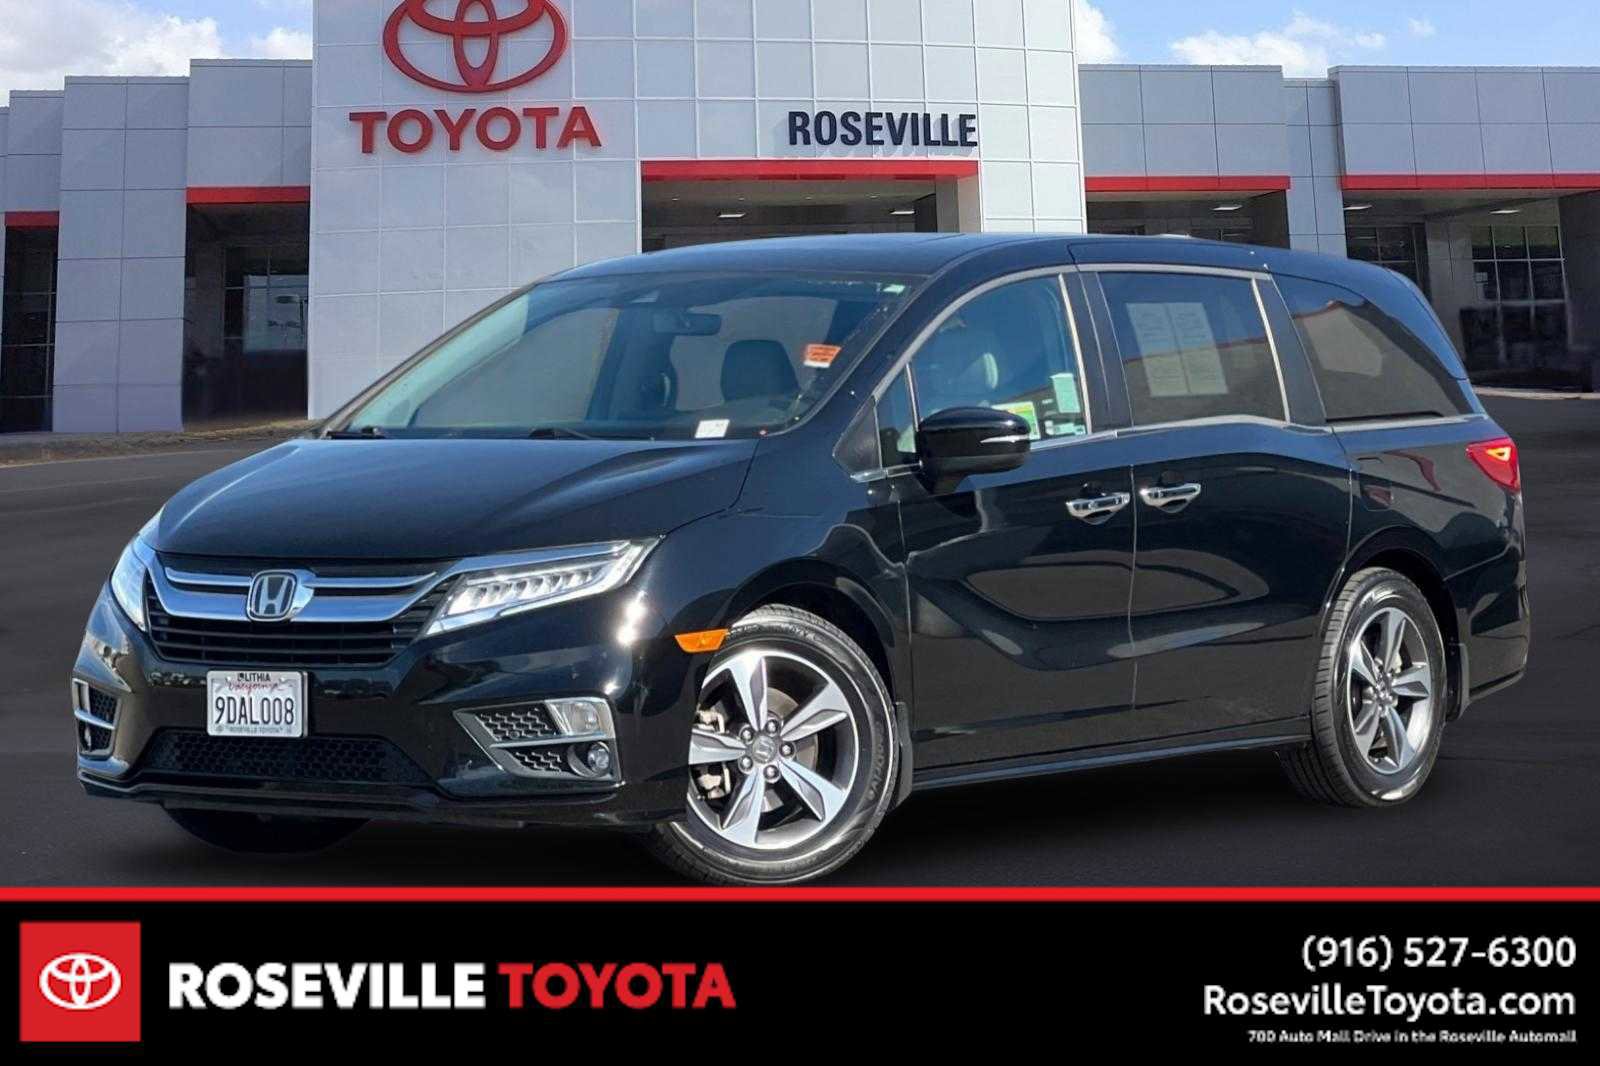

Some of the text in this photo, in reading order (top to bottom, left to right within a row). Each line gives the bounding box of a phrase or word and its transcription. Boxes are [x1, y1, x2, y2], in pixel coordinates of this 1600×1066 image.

[350, 105, 602, 154] TOYOTA
[788, 110, 978, 147] ROSEVILLE
[244, 672, 271, 682] LITHIA
[215, 696, 294, 725] 9DAL008
